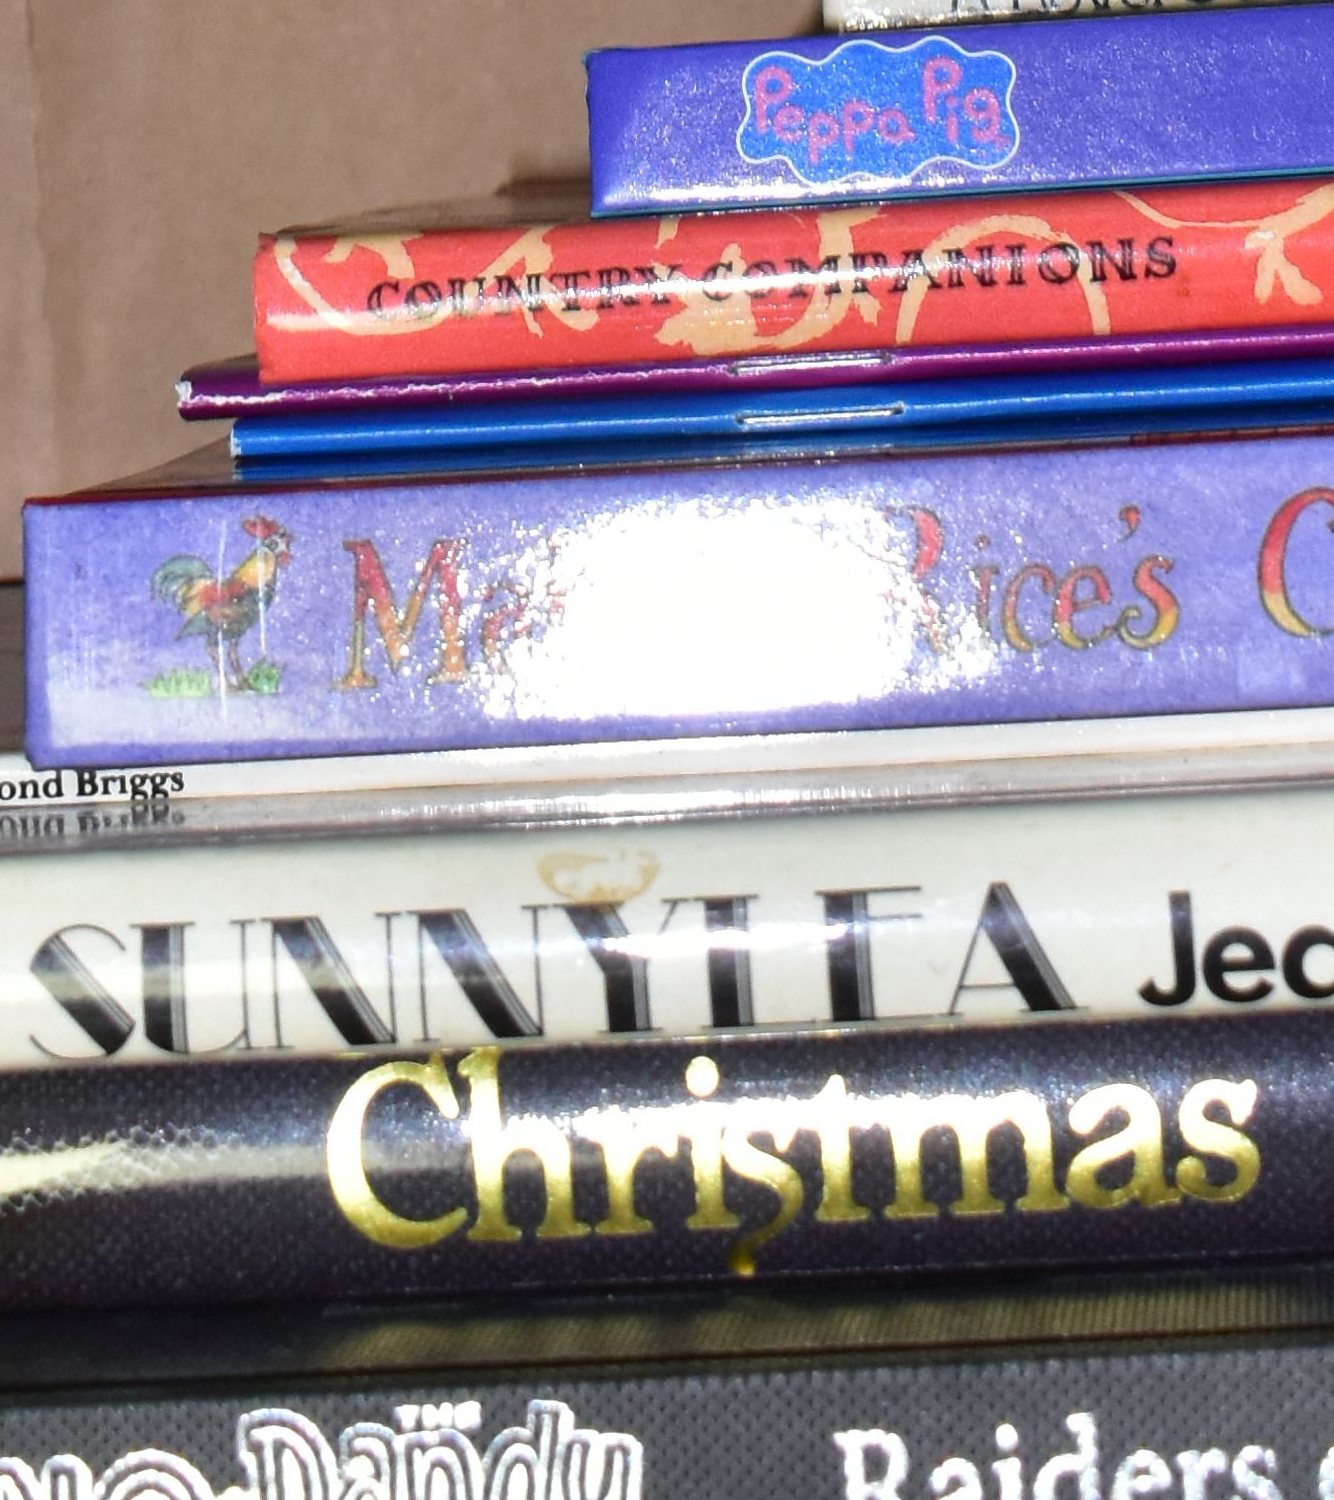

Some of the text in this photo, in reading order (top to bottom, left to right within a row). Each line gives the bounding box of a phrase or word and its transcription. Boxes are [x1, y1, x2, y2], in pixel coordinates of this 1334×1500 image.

[754, 66, 915, 163] Peppa
[923, 58, 1011, 152] Pig
[367, 263, 694, 322] COUNTRY
[76, 769, 184, 801] Briggs
[326, 1046, 1263, 1274] Christmas
